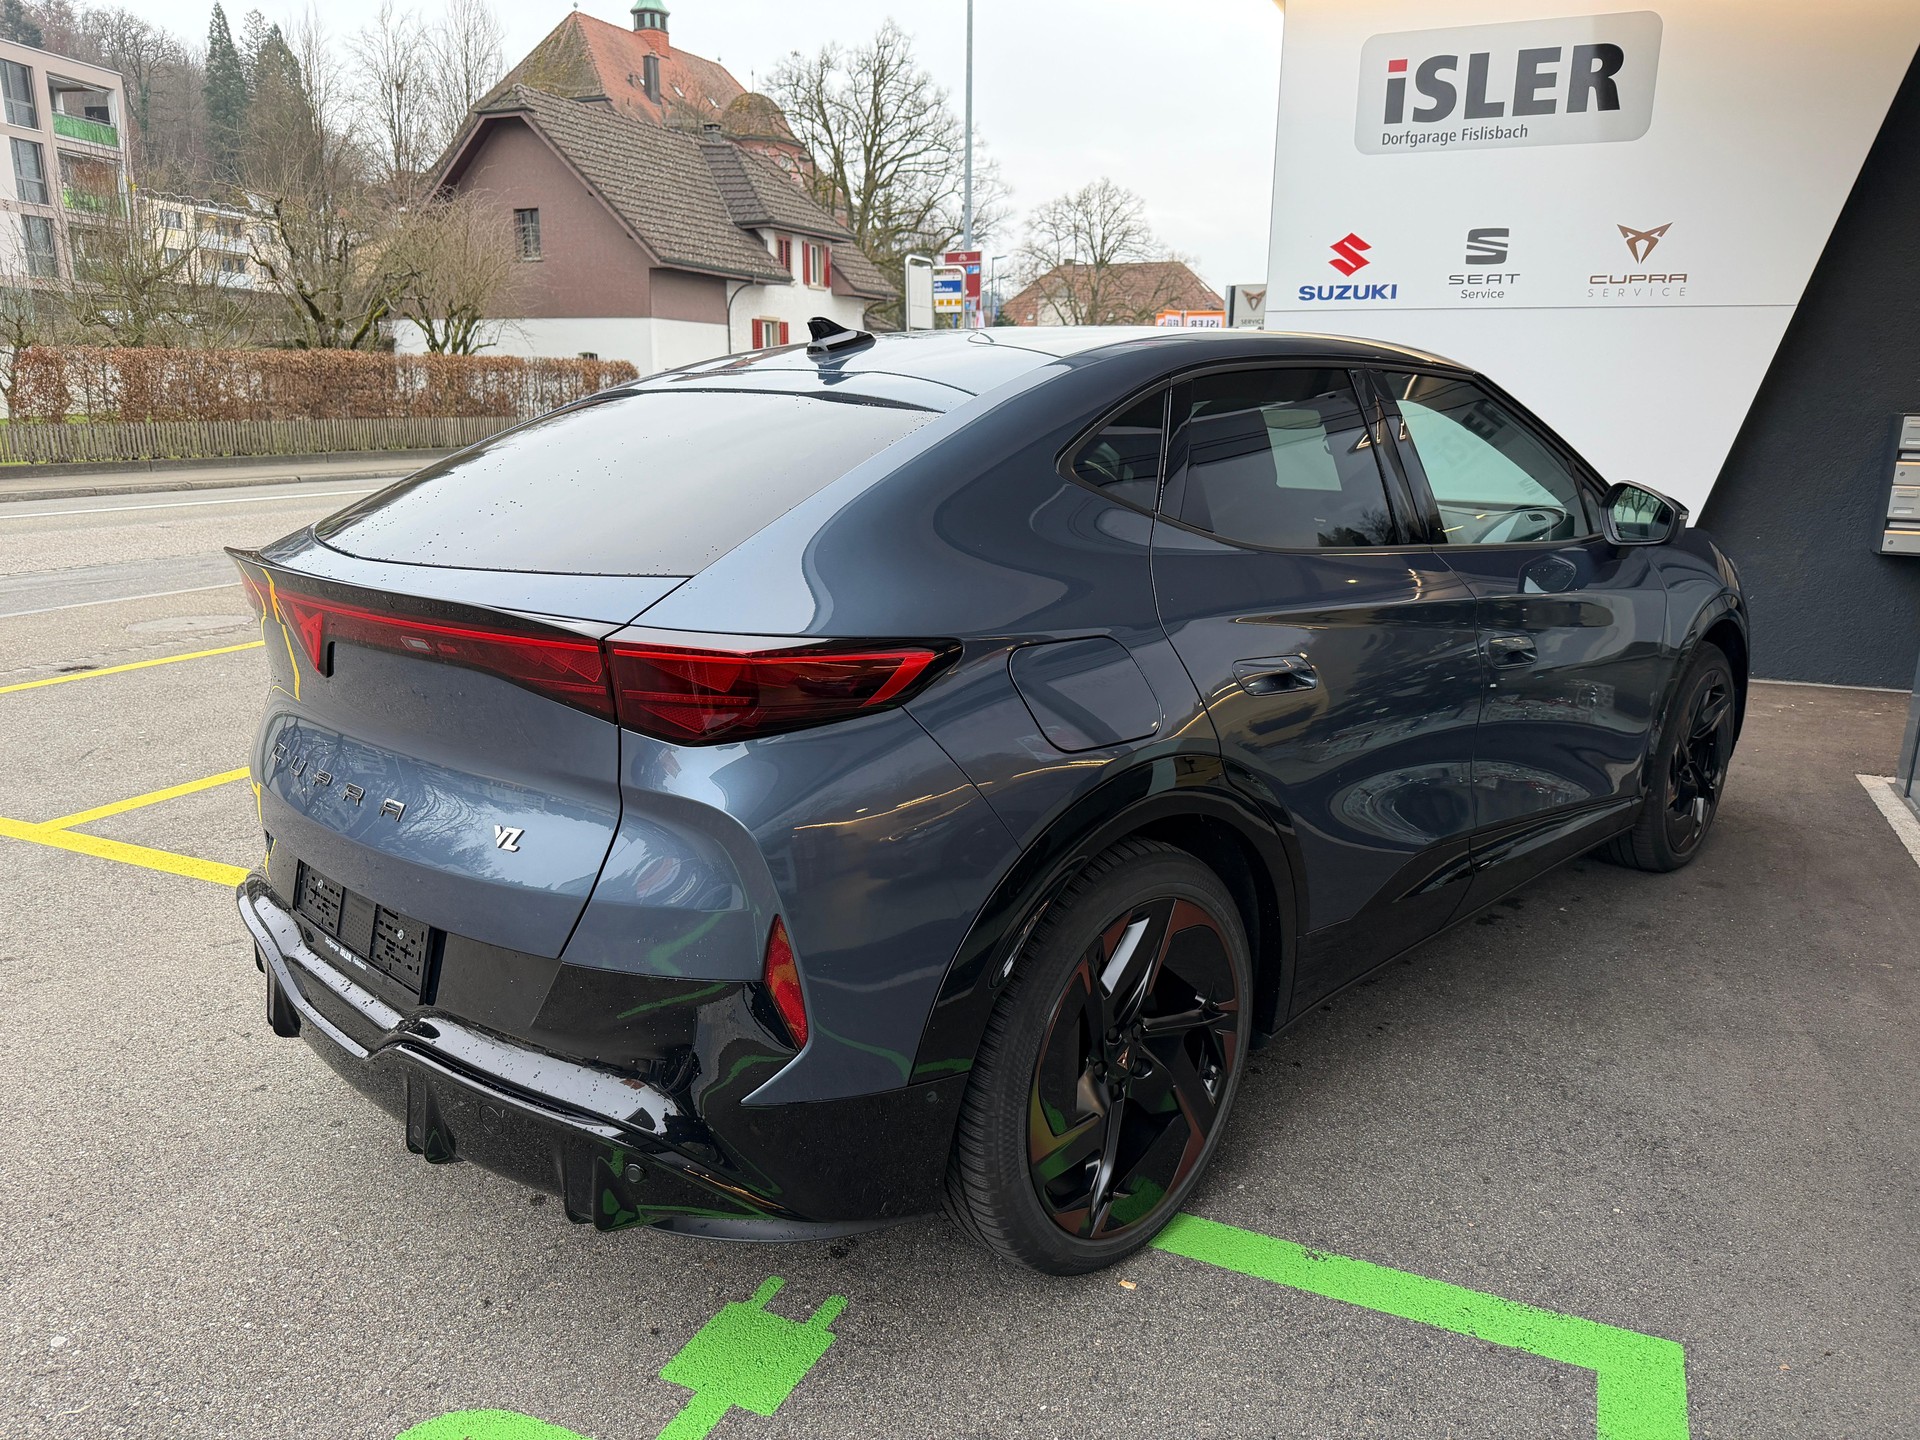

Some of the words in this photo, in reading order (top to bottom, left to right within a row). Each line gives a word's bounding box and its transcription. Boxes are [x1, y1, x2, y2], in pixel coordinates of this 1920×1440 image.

[1384, 43, 1624, 124] iSLER
[1381, 129, 1457, 147] Dorfgarage
[1461, 124, 1528, 141] Fislisbach
[1448, 273, 1520, 286] SEAT
[1589, 273, 1688, 284] CUPRA
[1298, 284, 1398, 301] SUZUKI
[1460, 289, 1505, 299] Service
[1587, 287, 1686, 298] SERVICE
[273, 742, 407, 823] CUPRA
